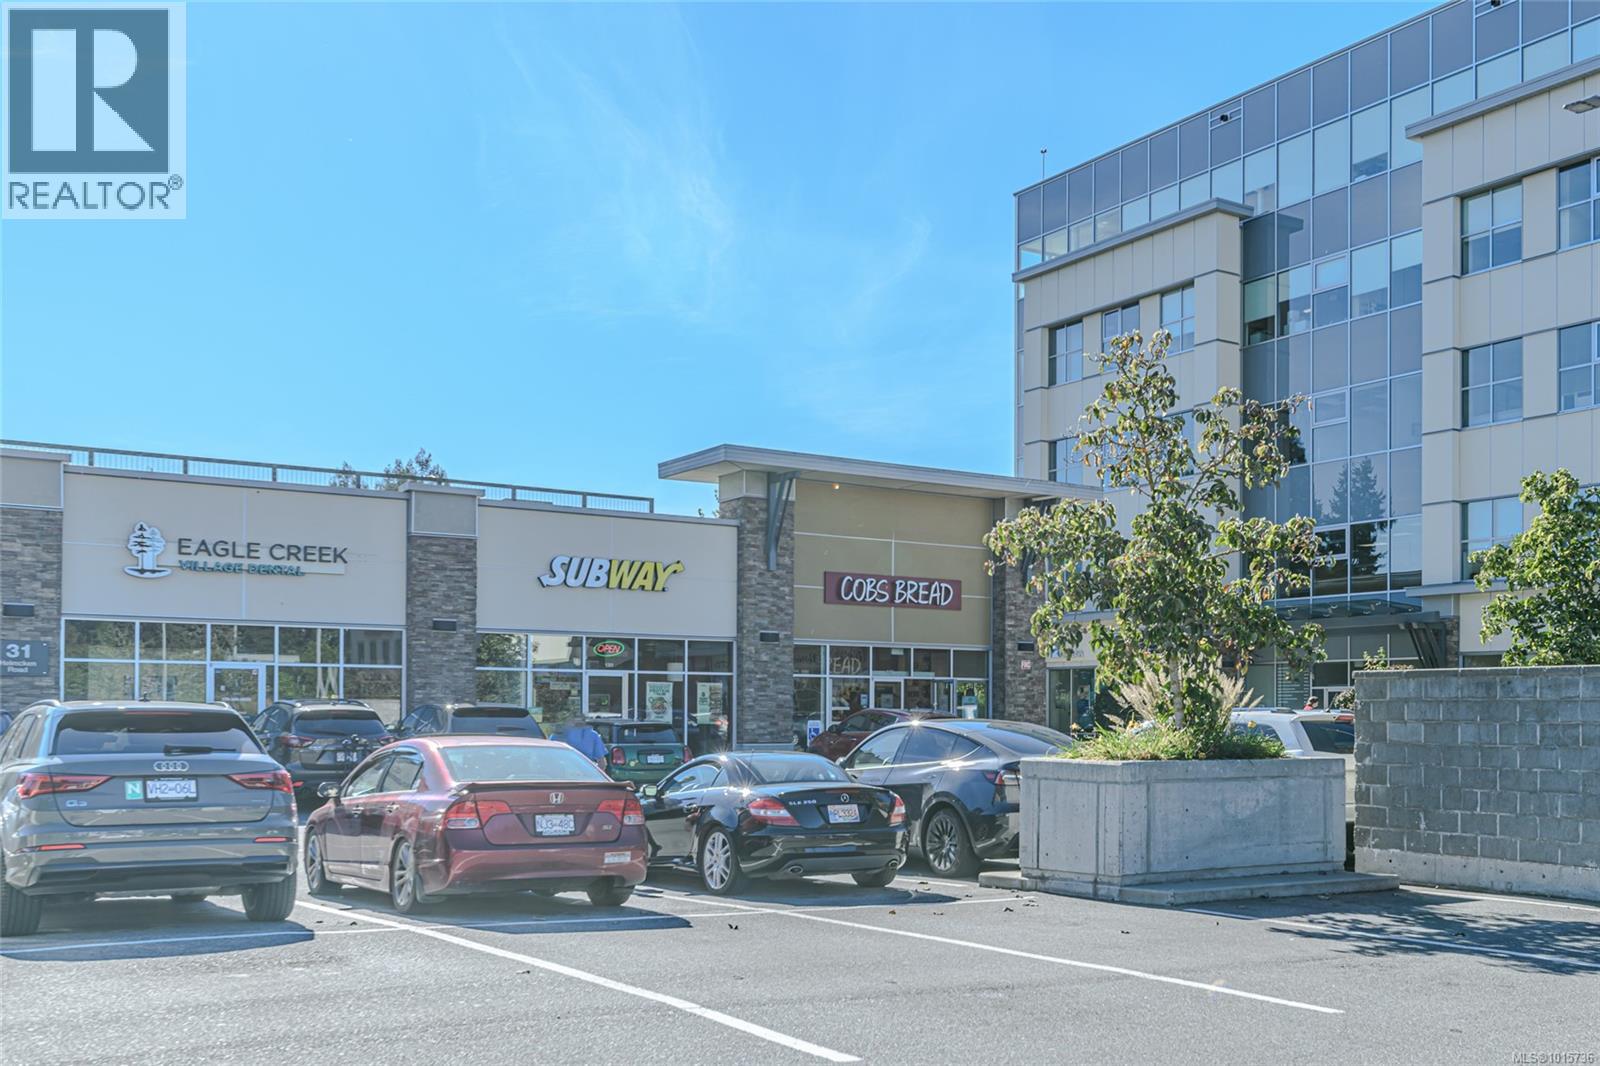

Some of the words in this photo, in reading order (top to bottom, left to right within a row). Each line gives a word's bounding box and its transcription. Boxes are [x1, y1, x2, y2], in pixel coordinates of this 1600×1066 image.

[177, 538, 261, 560] EAGLE
[269, 543, 348, 564] CREEK
[178, 559, 243, 574] VILLAGE
[247, 563, 305, 577] DENTAL
[537, 555, 685, 592] SUBWAY
[840, 575, 890, 603] COBS
[893, 579, 954, 606] BREAD
[6, 643, 31, 659] 31
[597, 643, 621, 654] OPEN
[830, 656, 862, 674] EAD
[127, 783, 139, 794] N
